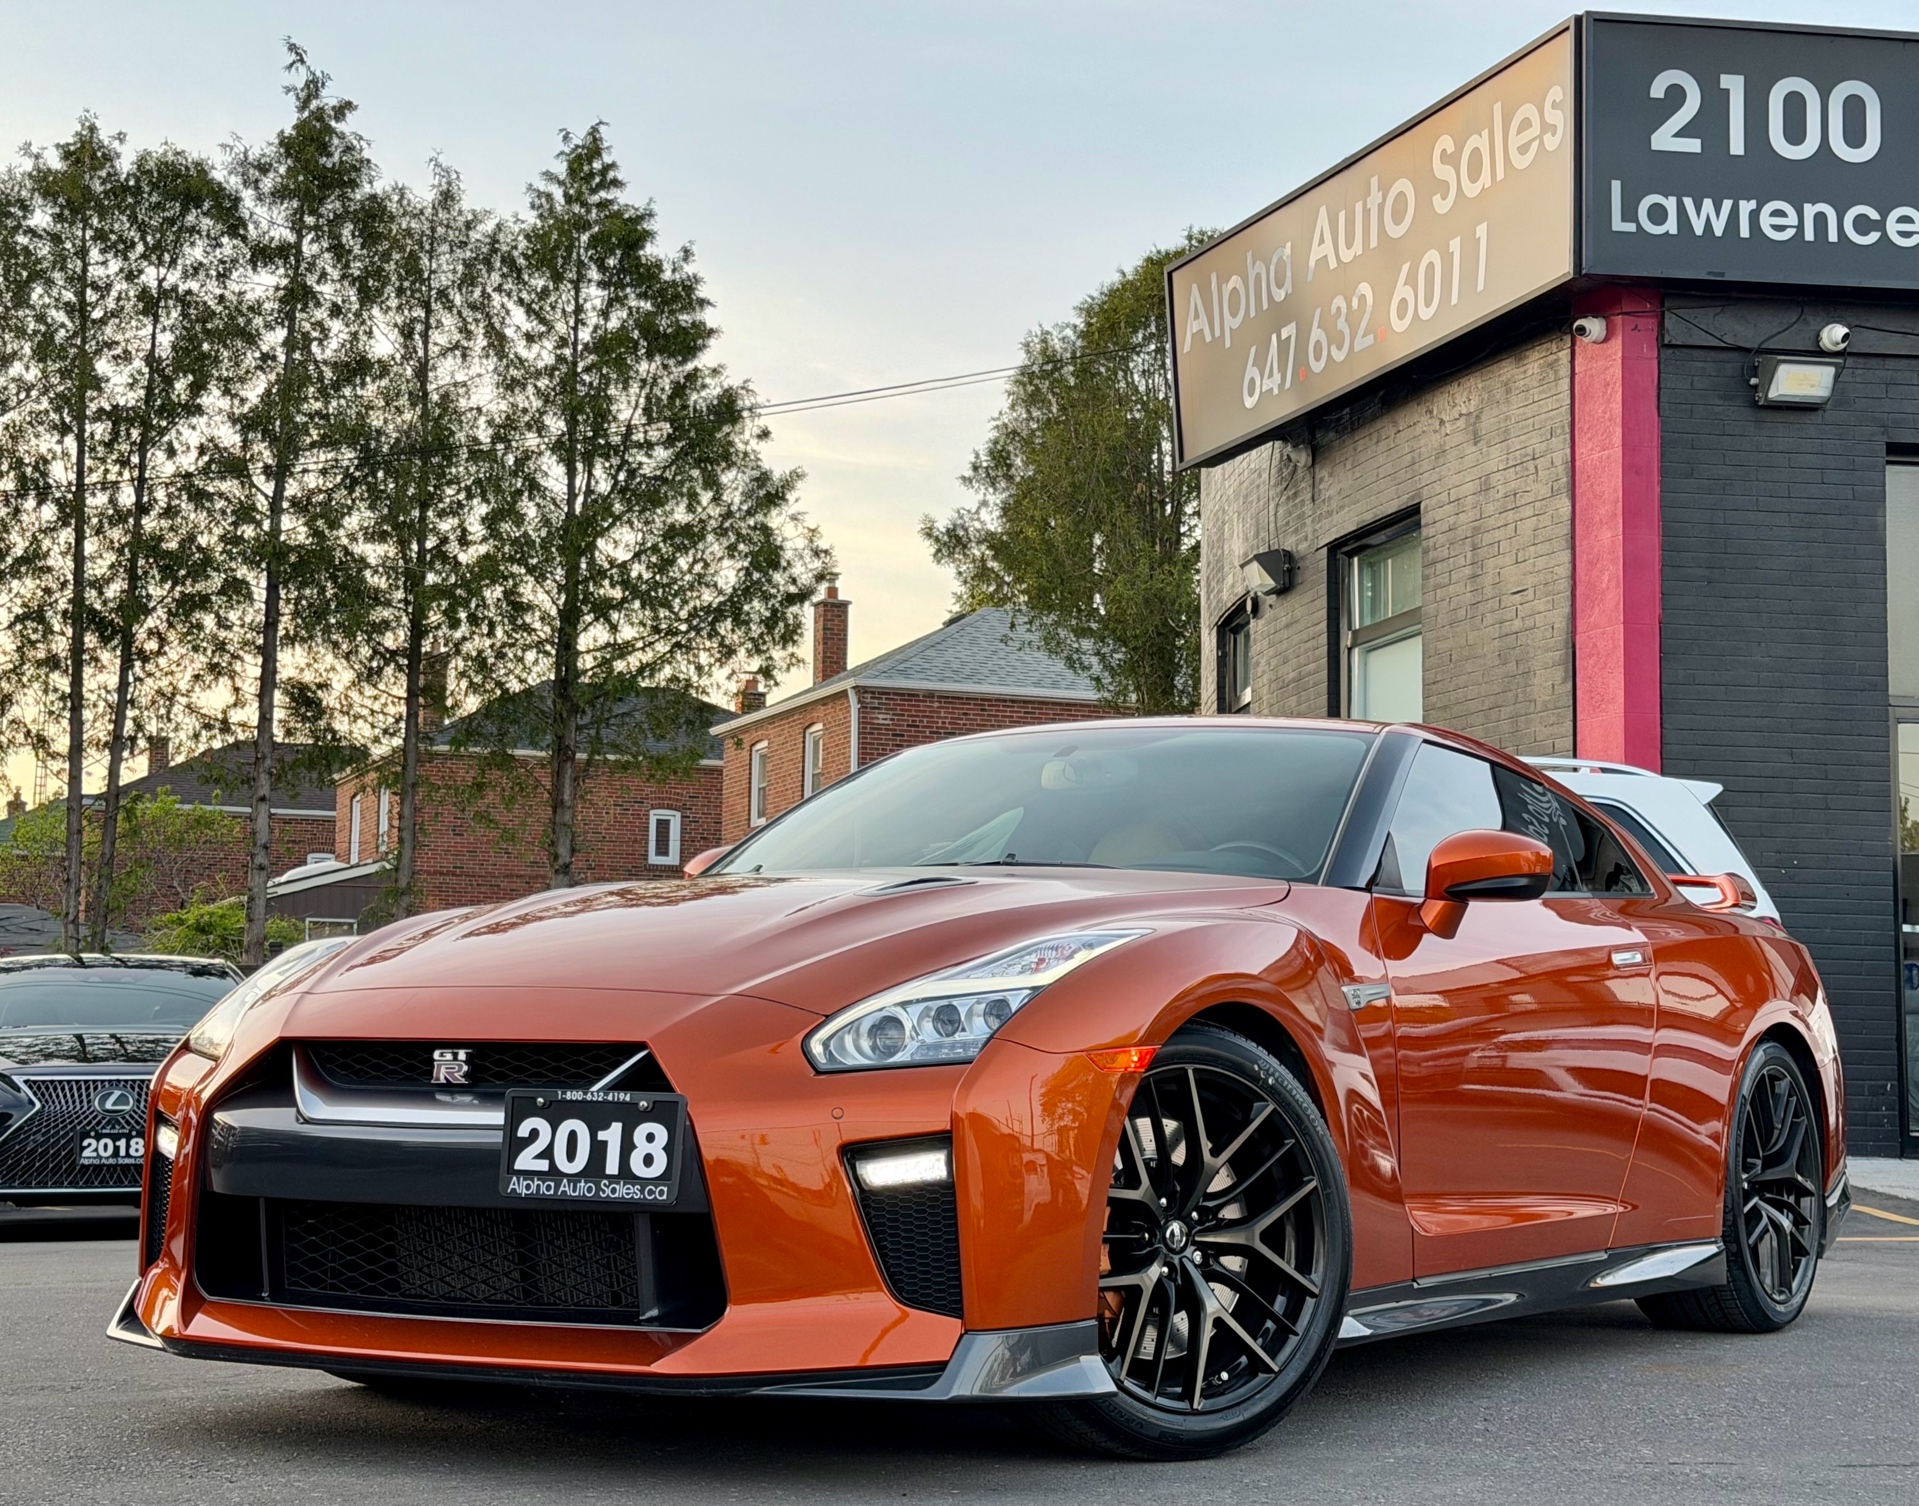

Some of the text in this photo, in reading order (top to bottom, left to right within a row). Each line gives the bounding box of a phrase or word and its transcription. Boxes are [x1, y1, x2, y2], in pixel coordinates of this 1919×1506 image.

[1650, 69, 1882, 164] 2100
[1183, 84, 1565, 354] Alpha Auto Sales
[1611, 179, 1919, 248] Lawrence
[1242, 220, 1489, 410] 647.632.6011
[557, 1090, 631, 1102] 1-800-632-4194
[80, 1157, 100, 1165] Alpha
[101, 1157, 117, 1165] Auto
[81, 1137, 145, 1158] 2018
[513, 1116, 669, 1178] 2018
[507, 1176, 668, 1200] Alpha Auto Sales.ca
